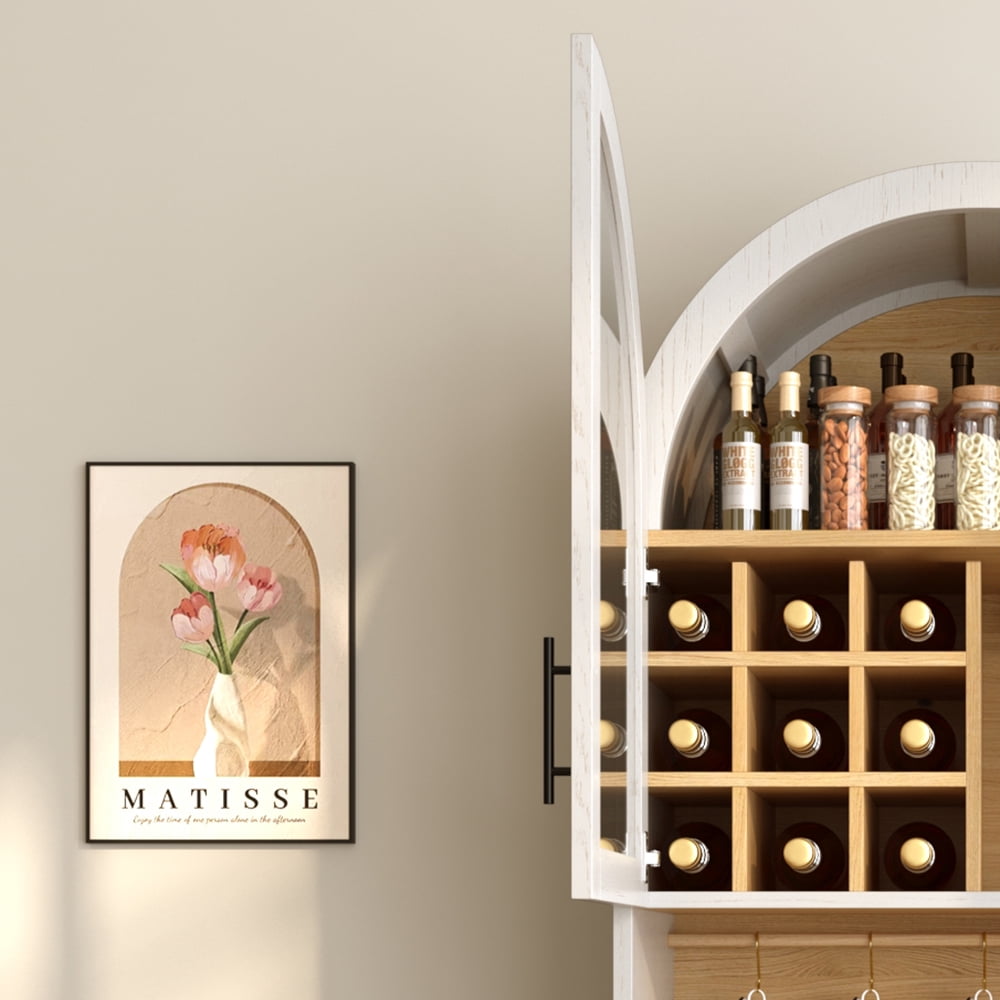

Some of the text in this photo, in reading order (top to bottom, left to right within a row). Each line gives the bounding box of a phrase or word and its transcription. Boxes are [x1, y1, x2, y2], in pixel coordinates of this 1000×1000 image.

[122, 788, 319, 809] MATISSE
[154, 814, 165, 823] the
[184, 814, 192, 824] of
[250, 815, 258, 823] in
[259, 814, 271, 823] the
[272, 814, 306, 825] afternoon
